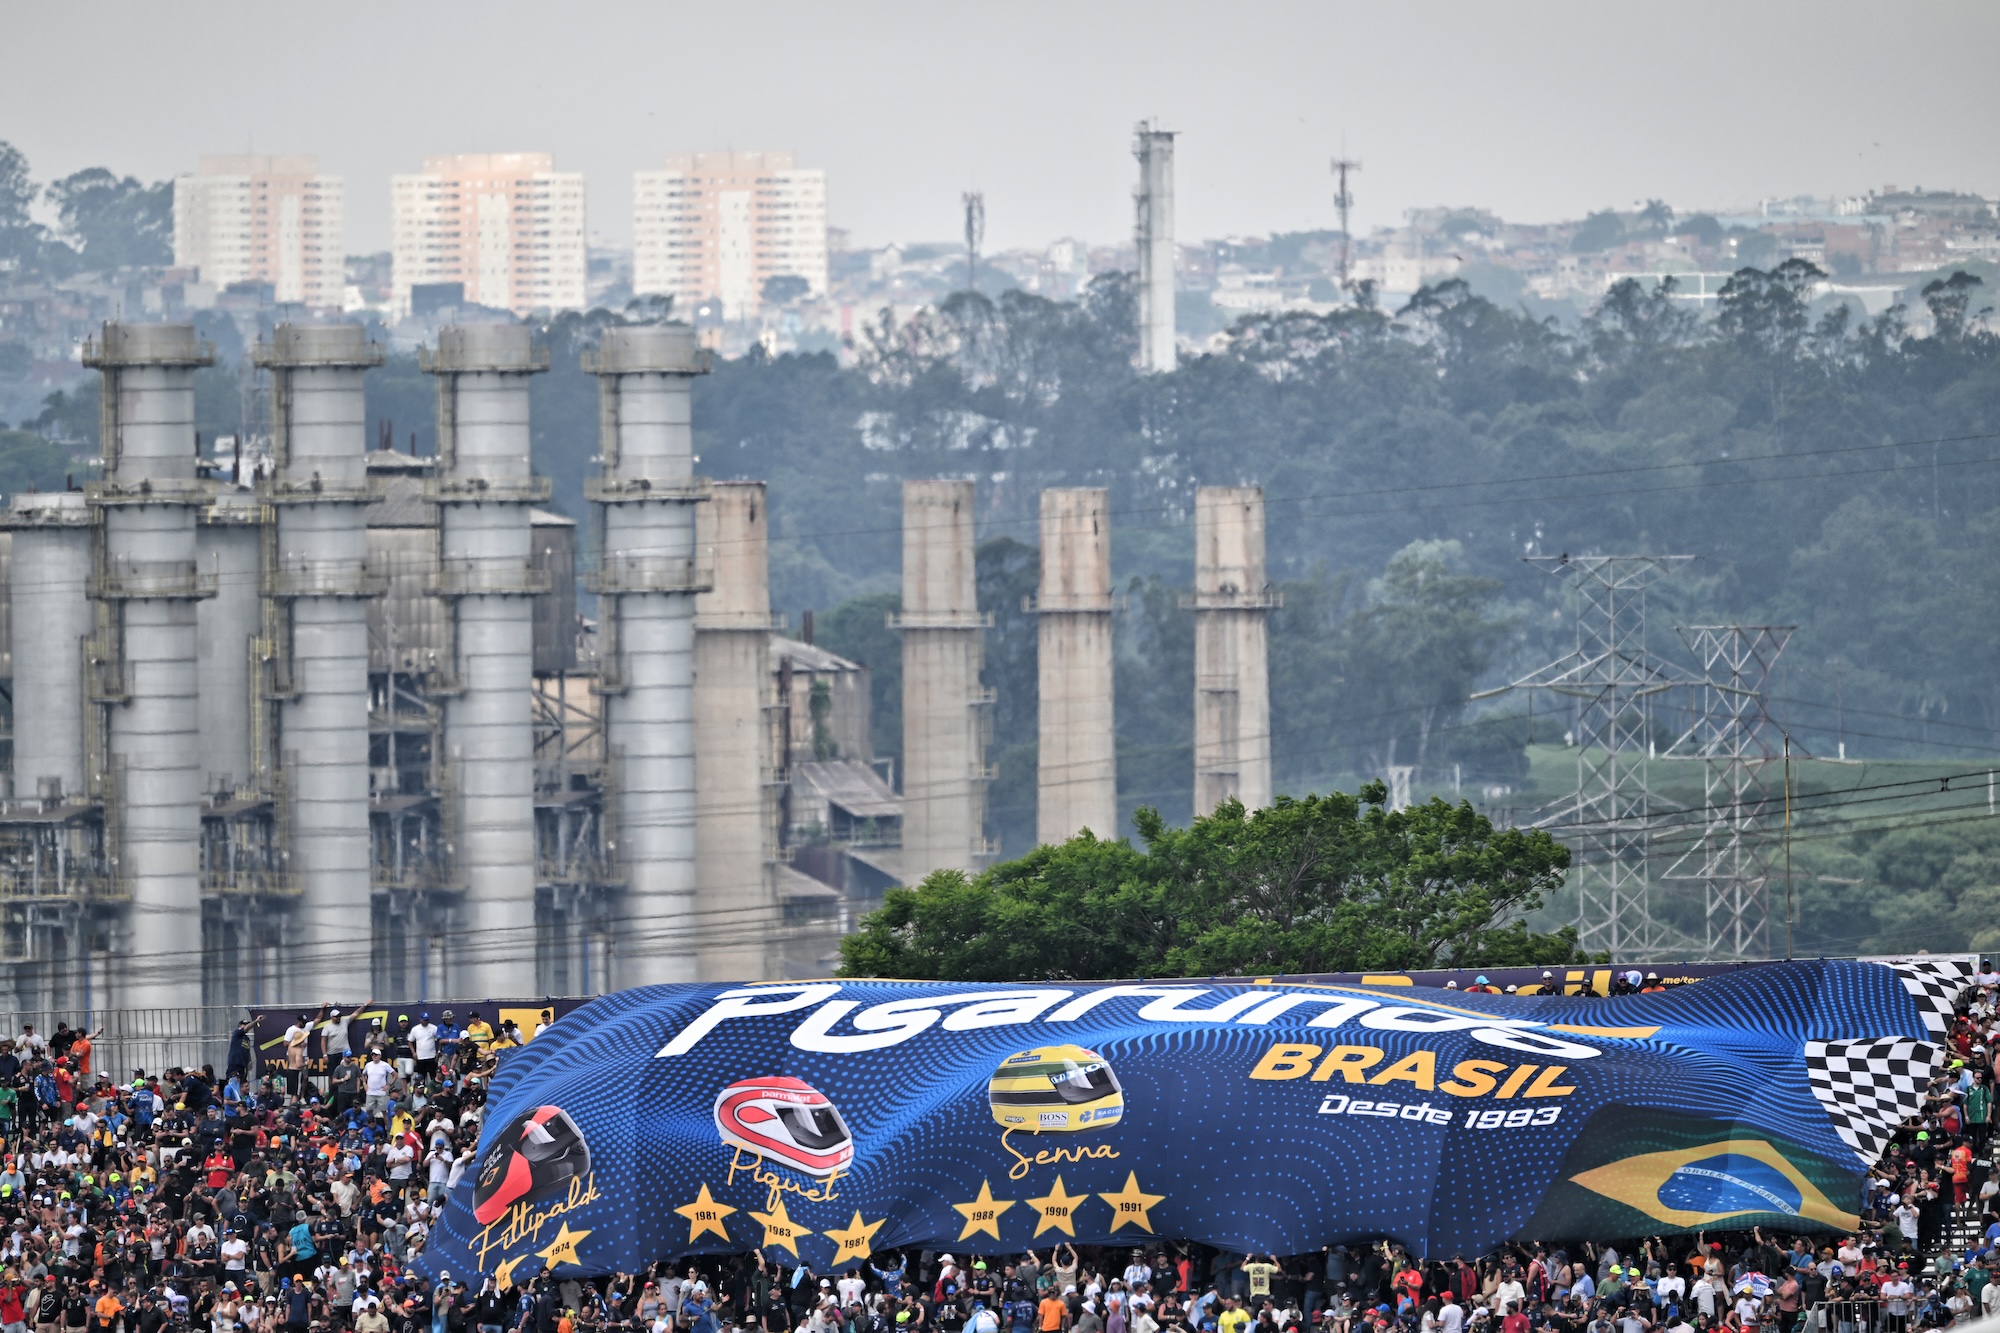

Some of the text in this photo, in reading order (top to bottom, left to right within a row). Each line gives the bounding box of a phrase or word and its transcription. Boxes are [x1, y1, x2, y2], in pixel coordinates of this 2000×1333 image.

[1249, 1043, 1577, 1099] BRASIL
[761, 1090, 812, 1103] parmalat
[1040, 1112, 1067, 1121] BOSS
[1097, 1108, 1123, 1117] NACIO
[1318, 1095, 1562, 1130] Desde 1993
[1001, 1120, 1120, 1180] Senna
[721, 1141, 849, 1213] Piquet
[1683, 1167, 1725, 1179] ORDEM
[1045, 1206, 1068, 1217] 1990
[1119, 1202, 1142, 1212] 1991
[695, 1211, 717, 1221] 1981
[971, 1210, 994, 1221] 1988
[768, 1224, 791, 1238] 1983
[551, 1241, 571, 1257] 1974
[844, 1236, 866, 1249] 1987
